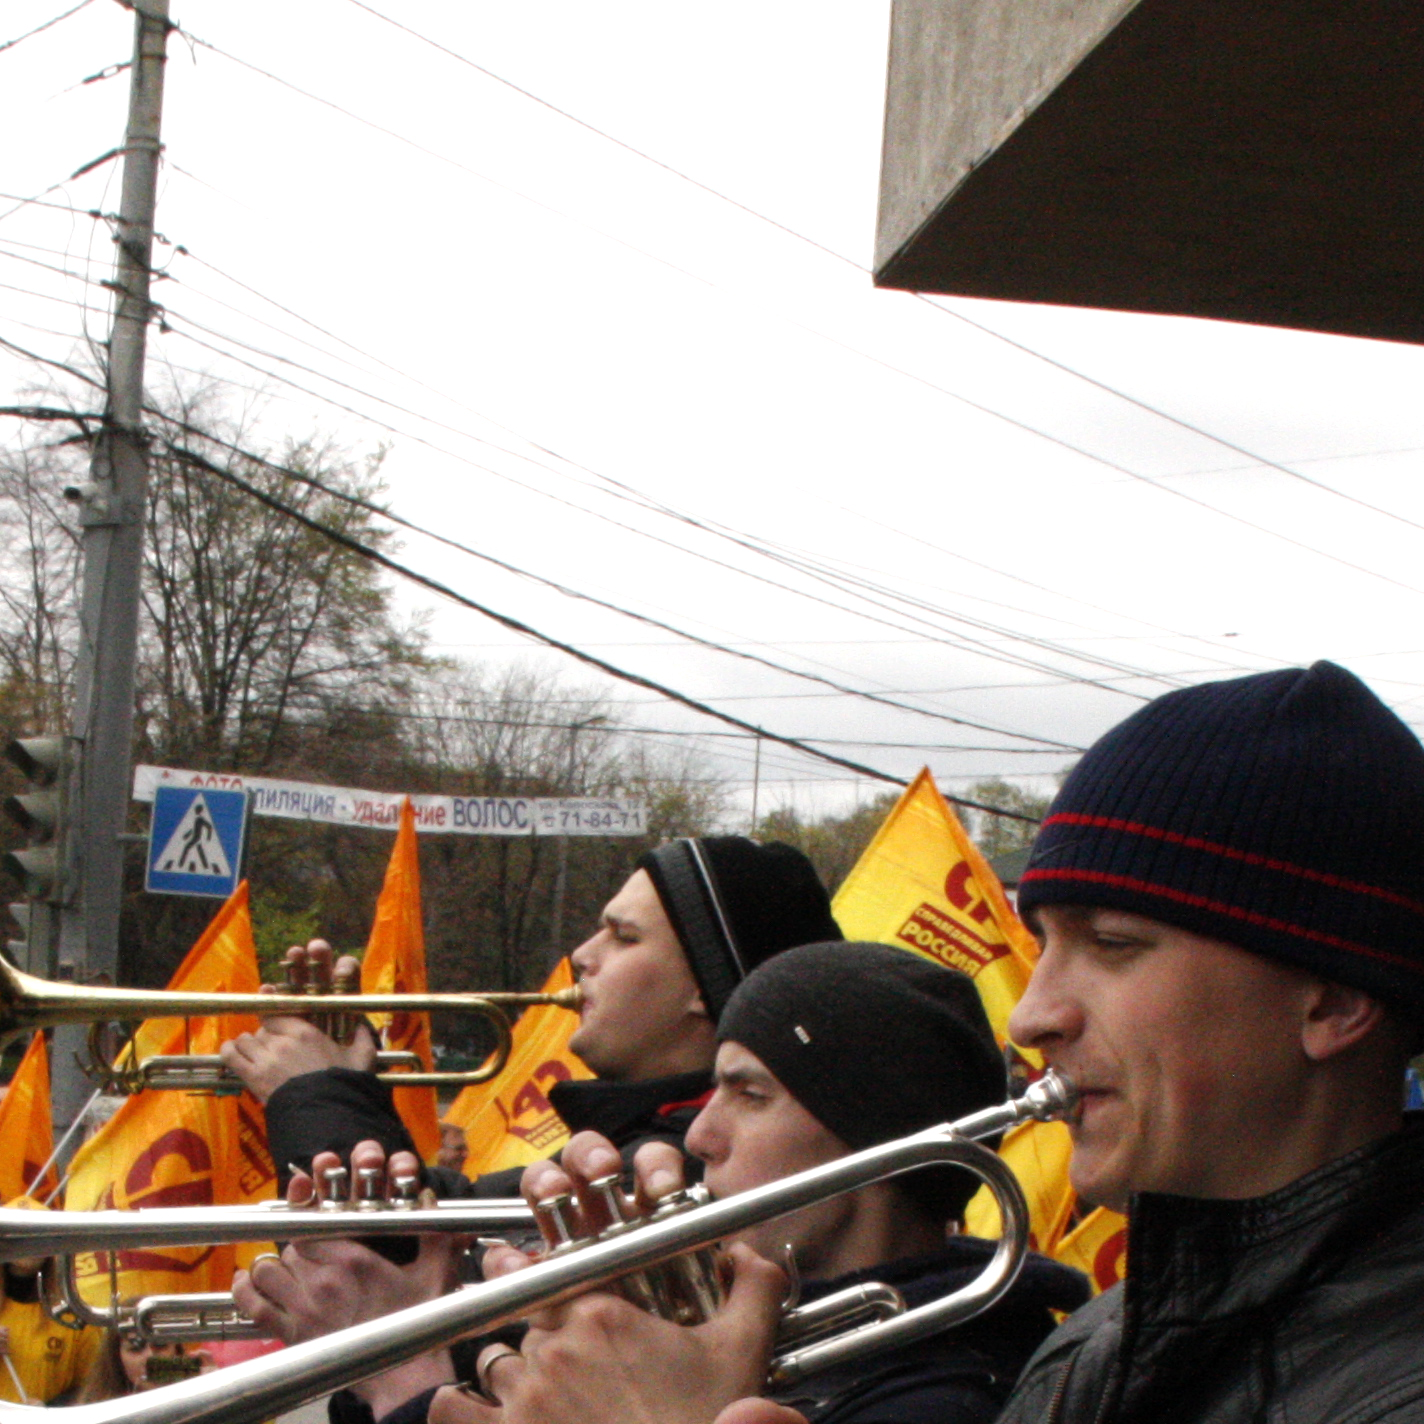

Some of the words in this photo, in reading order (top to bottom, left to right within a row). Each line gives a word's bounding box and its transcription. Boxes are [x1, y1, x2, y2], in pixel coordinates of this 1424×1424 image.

[352, 799, 446, 826] удалние
[453, 797, 529, 829] ВОЛОС
[561, 811, 641, 828] 71-84-71
[900, 920, 982, 977] РОССИЯ
